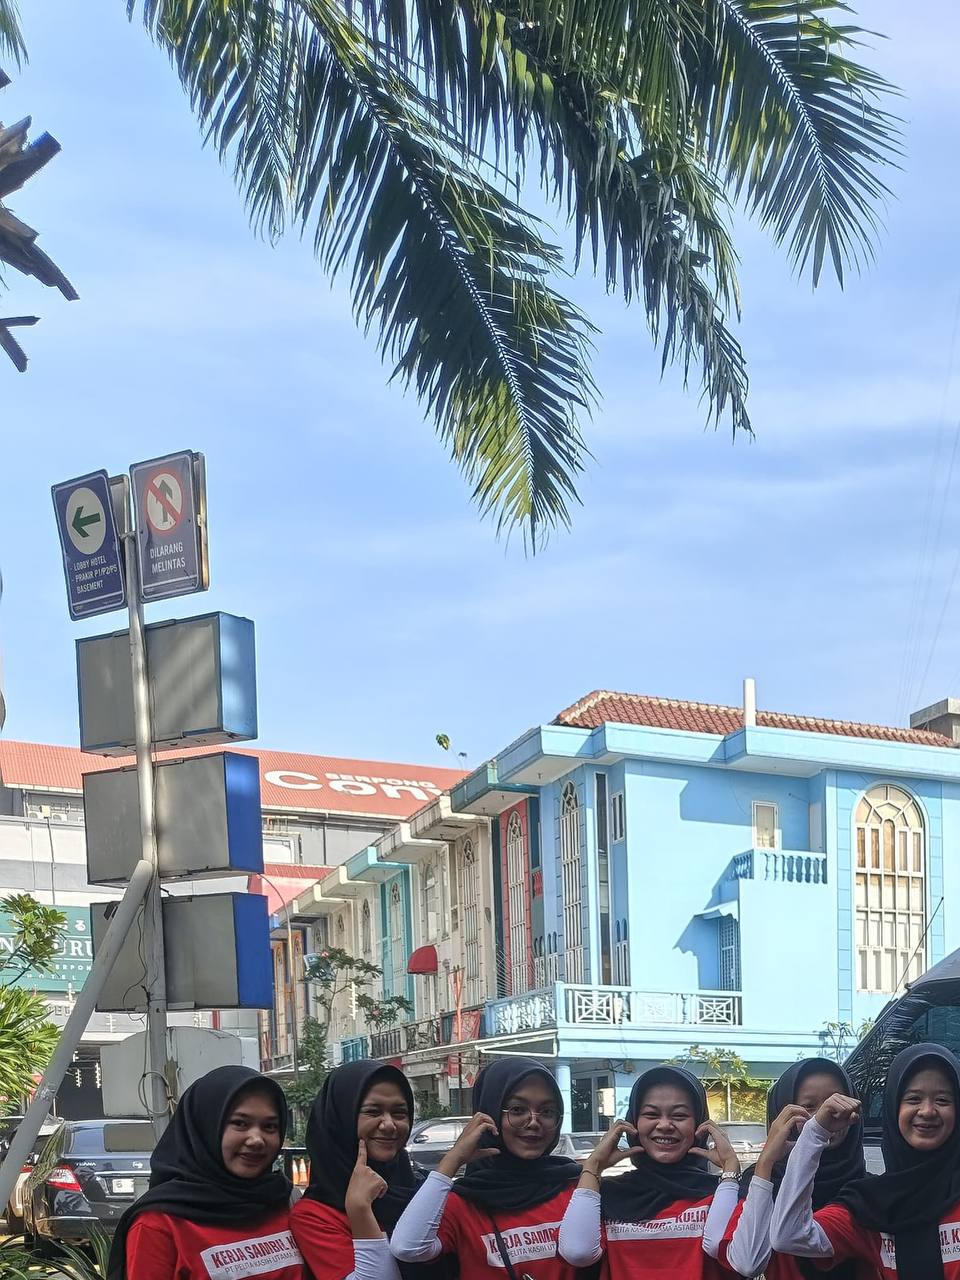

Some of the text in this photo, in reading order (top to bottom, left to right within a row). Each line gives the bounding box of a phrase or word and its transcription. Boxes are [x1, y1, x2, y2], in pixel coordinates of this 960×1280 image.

[150, 542, 183, 559] DILARANG
[73, 555, 107, 572] LOBBY HOTEL
[151, 557, 186, 575] MELINTAS
[77, 580, 104, 594] BASEMENT
[264, 770, 443, 801] Con
[325, 773, 436, 788] SERPONG
[675, 1209, 708, 1224] KULIA
[489, 1233, 522, 1254] KRJA
[211, 1247, 246, 1269] KERJA
[245, 1238, 290, 1260] SAMBIL
